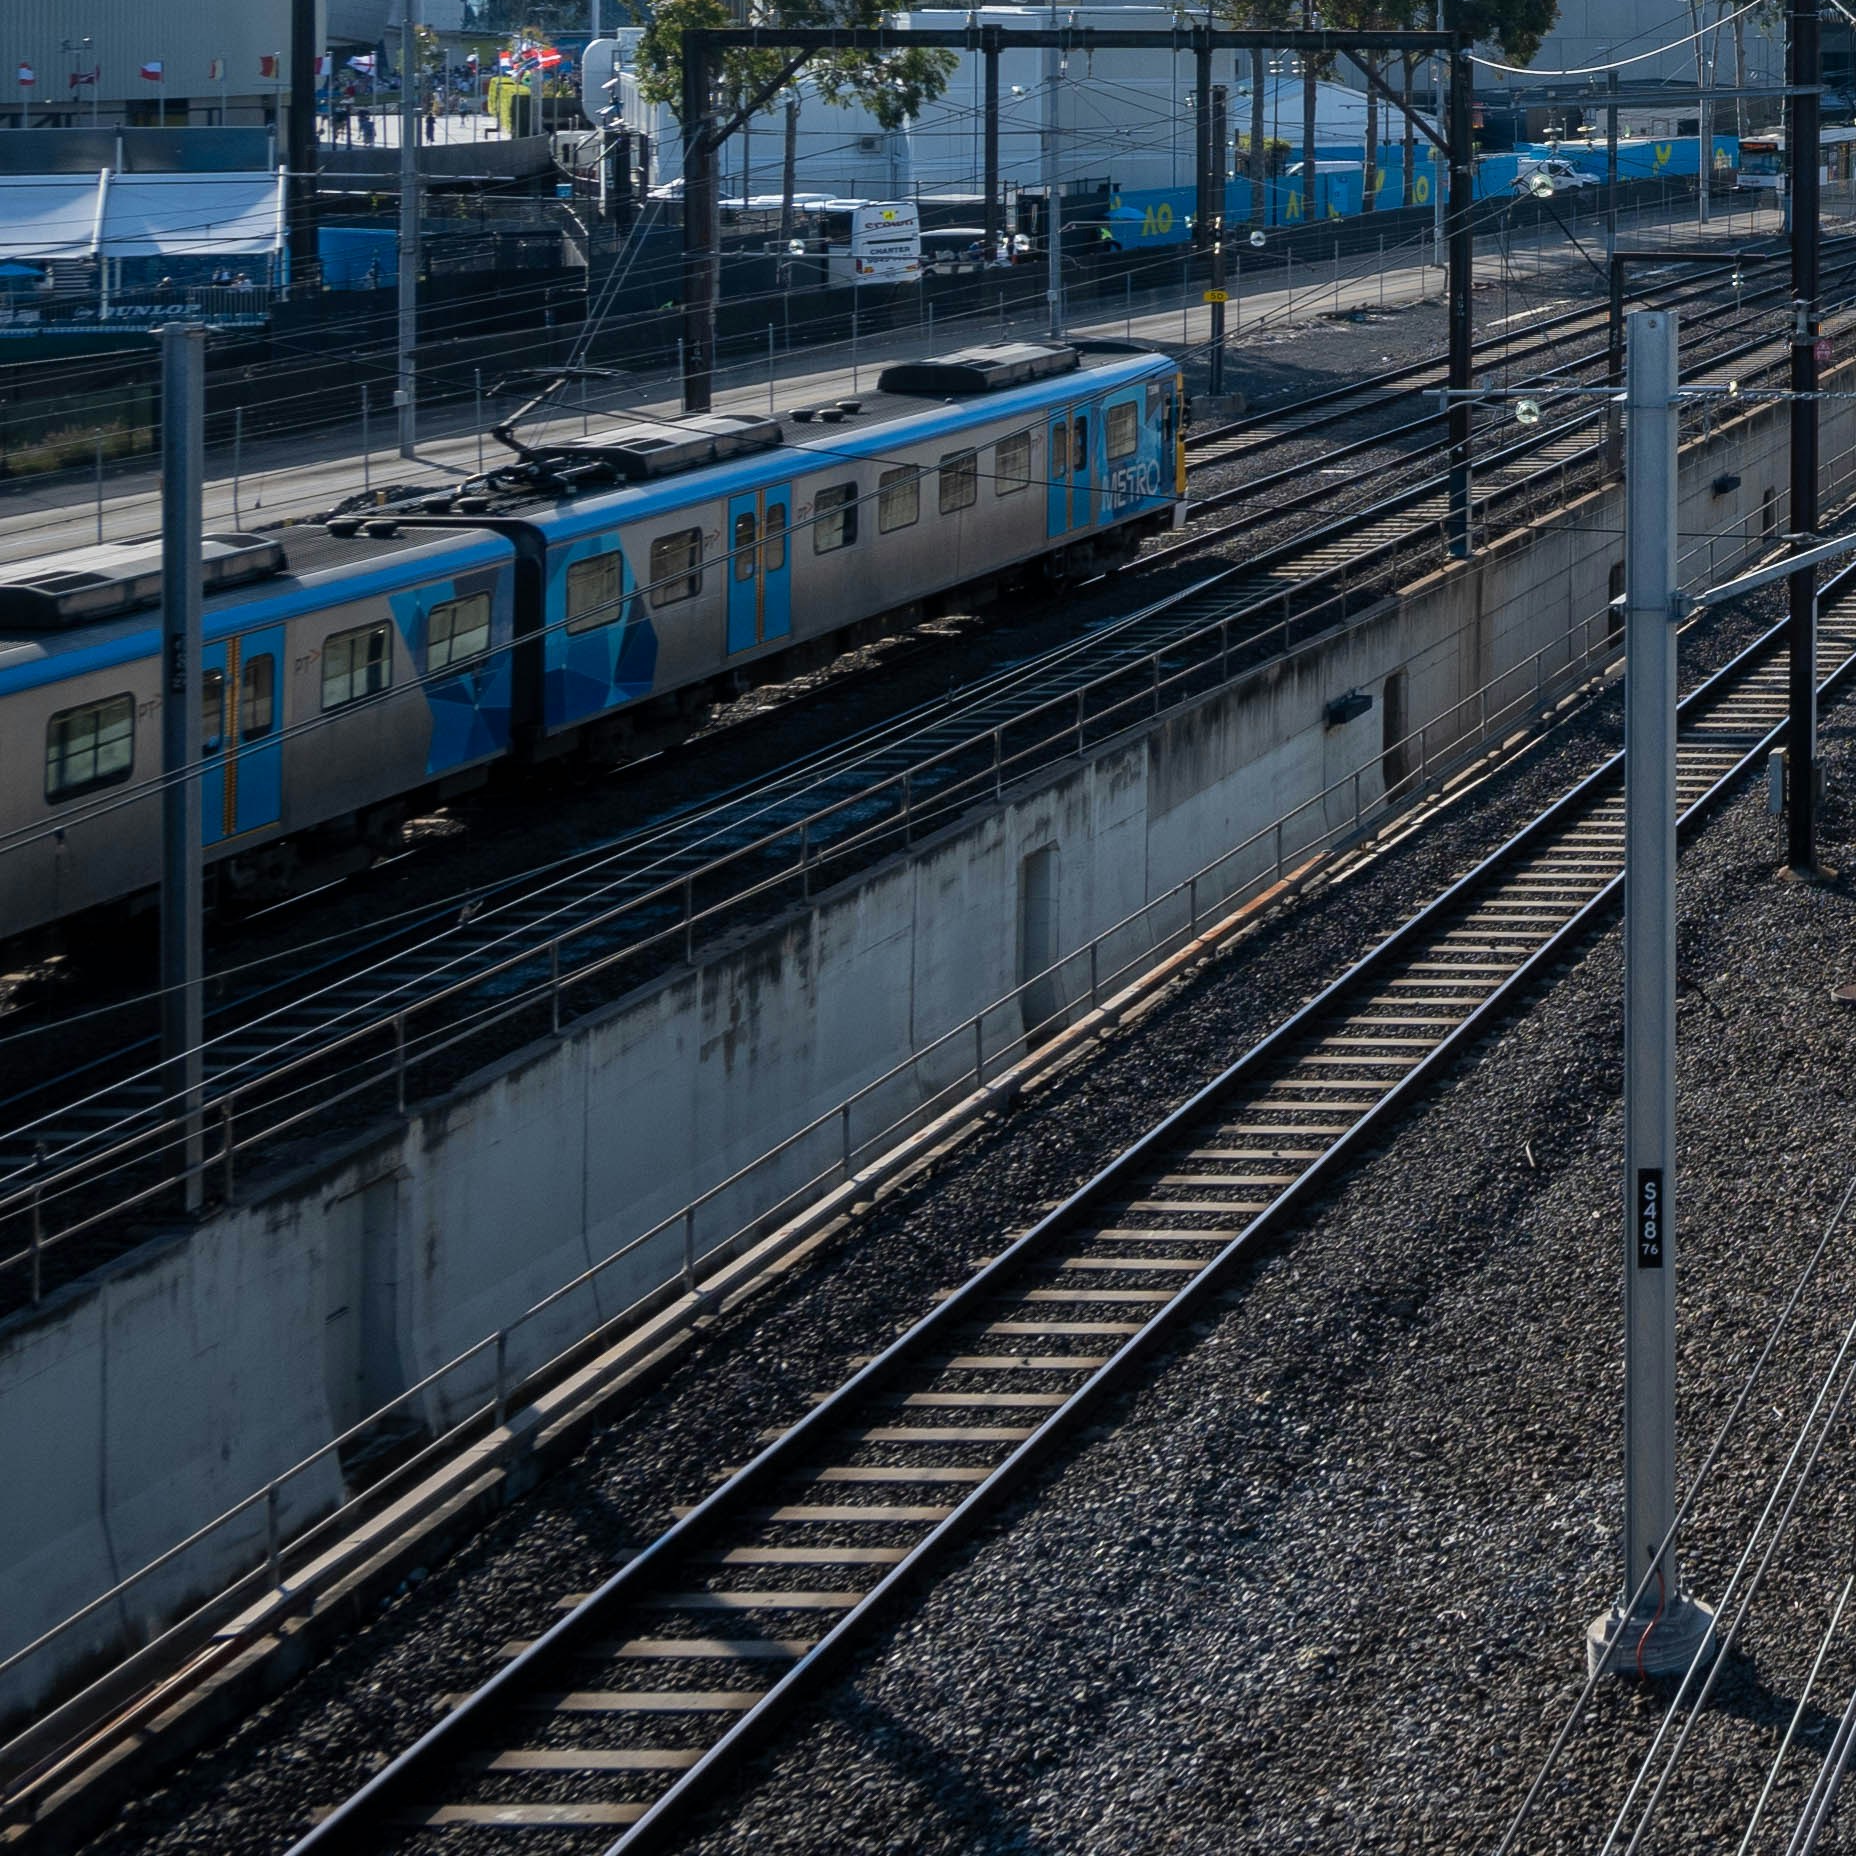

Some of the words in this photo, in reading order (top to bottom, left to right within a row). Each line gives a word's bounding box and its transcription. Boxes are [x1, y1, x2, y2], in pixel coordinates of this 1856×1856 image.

[870, 246, 911, 255] CHARTER
[1210, 292, 1225, 300] 50
[99, 304, 202, 316] DUNLOP
[1102, 458, 1161, 511] METRO
[1643, 1181, 1657, 1239] S48
[1641, 1243, 1659, 1256] 76
